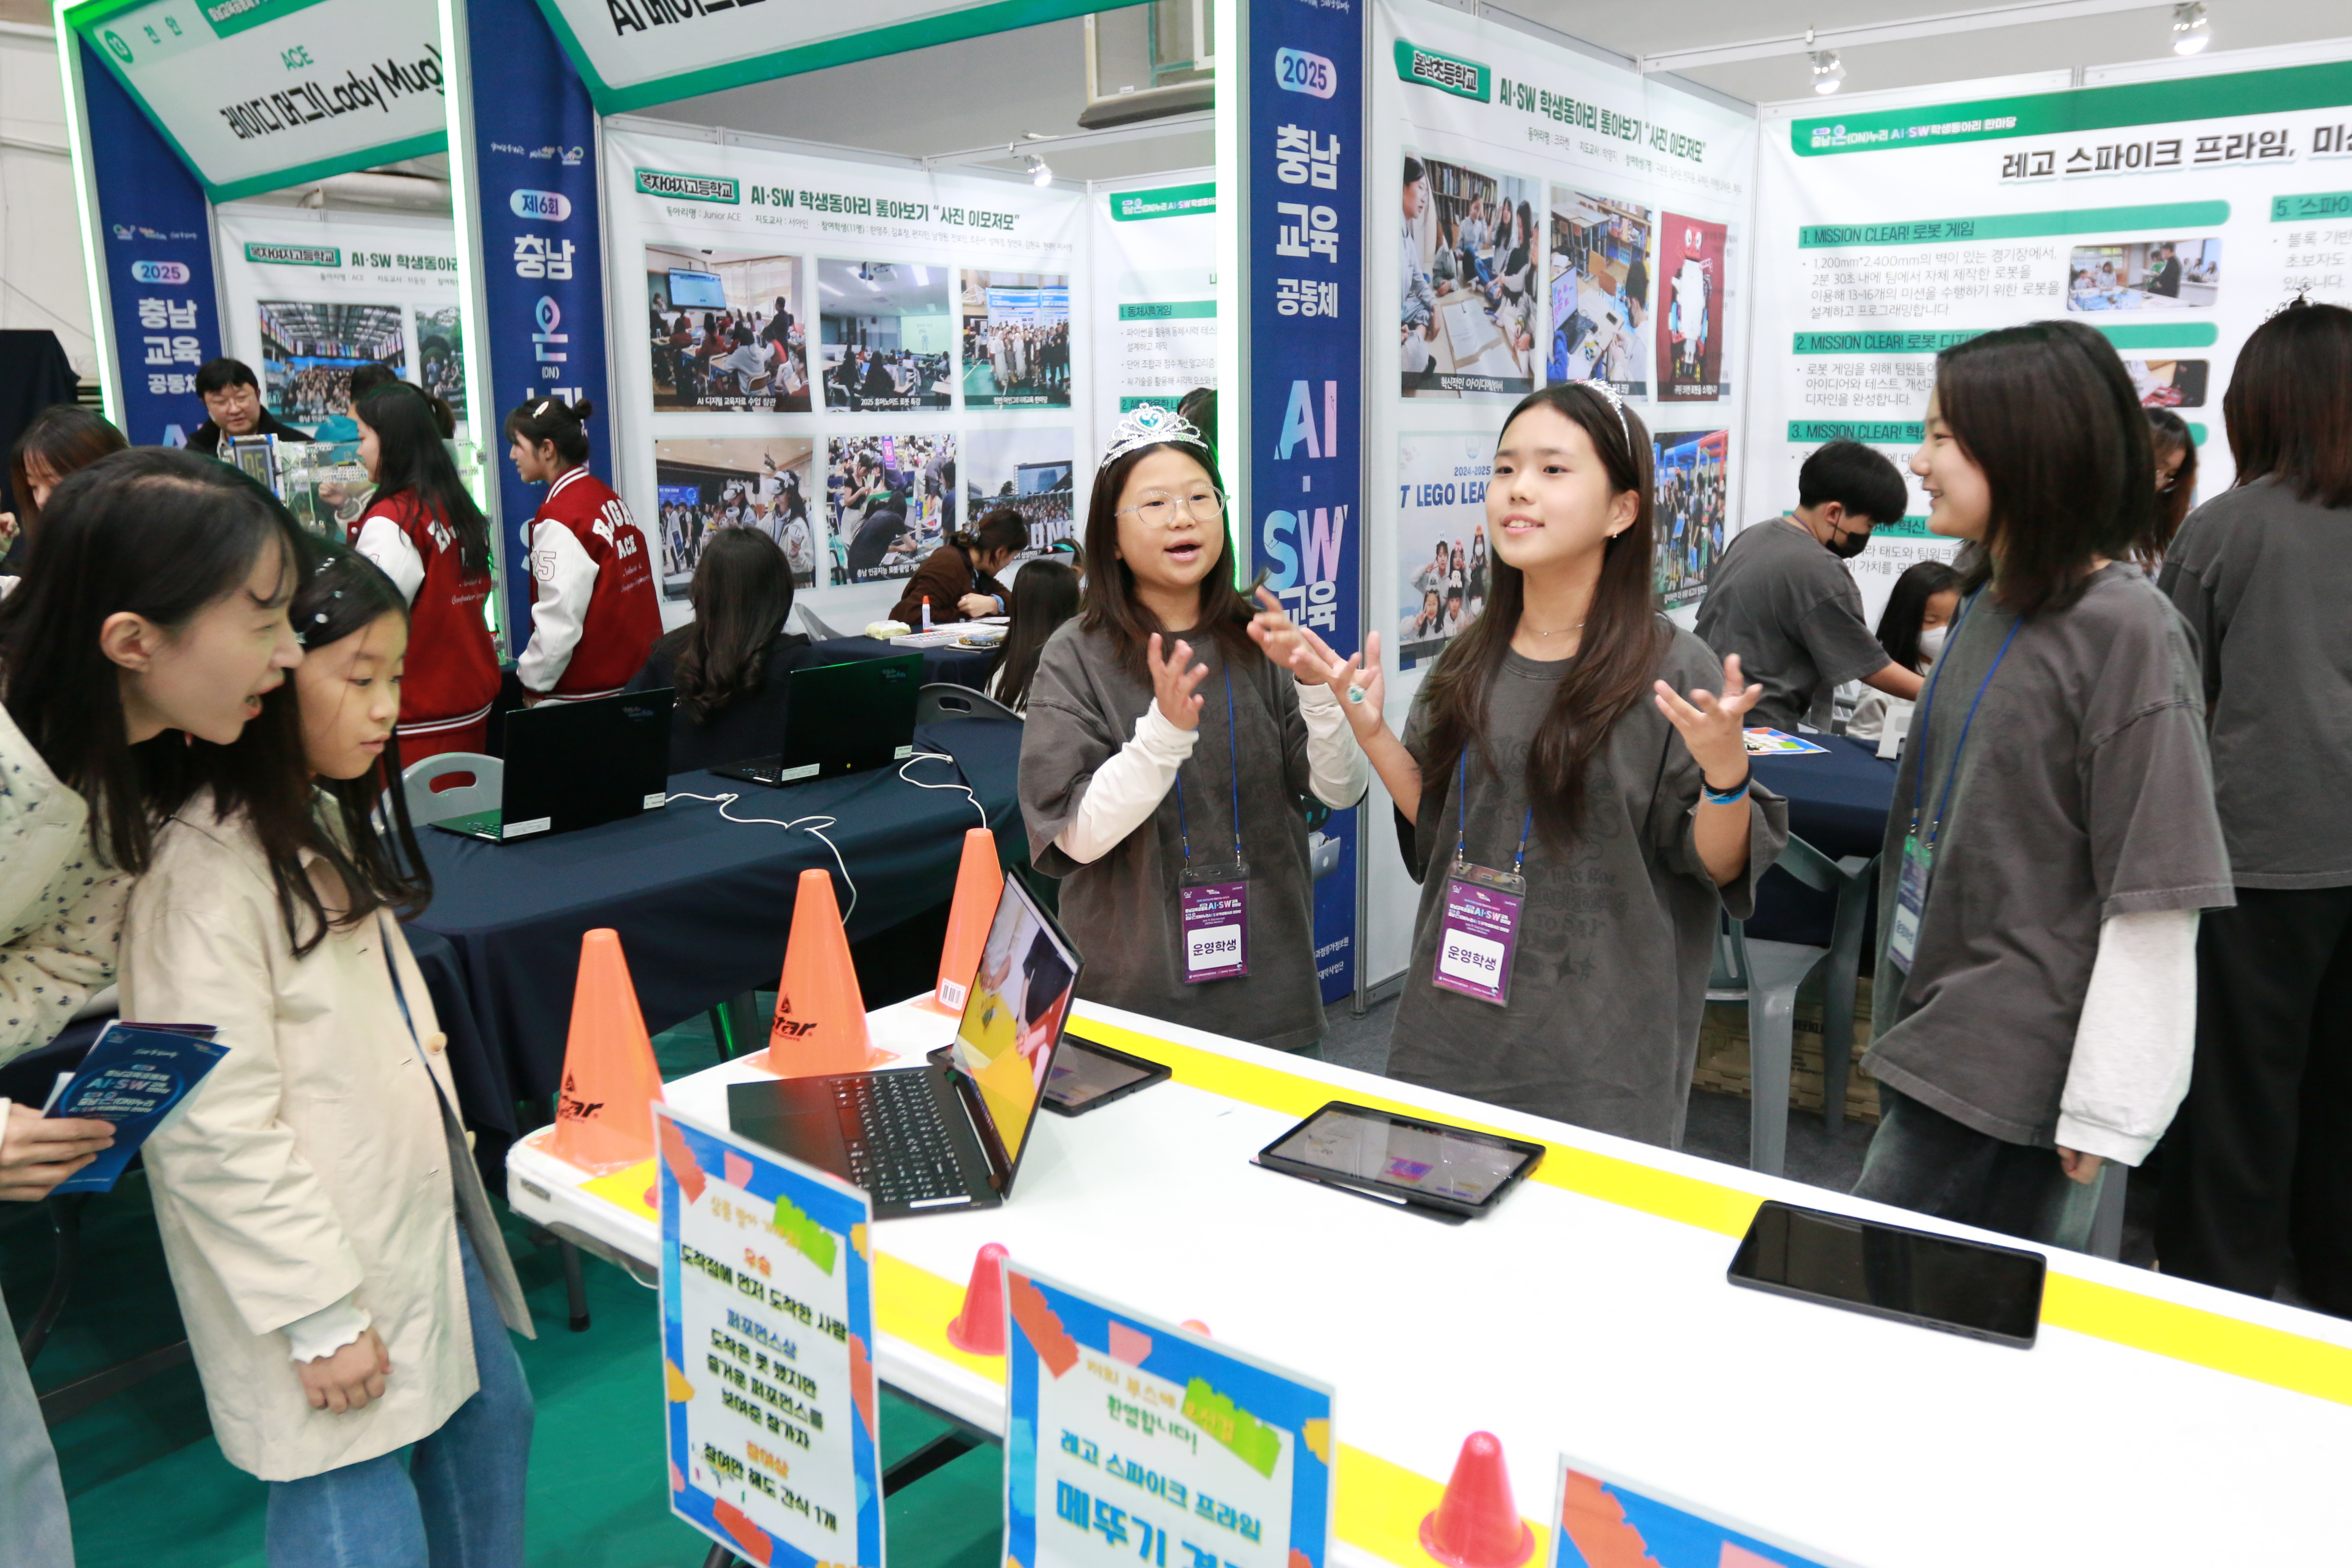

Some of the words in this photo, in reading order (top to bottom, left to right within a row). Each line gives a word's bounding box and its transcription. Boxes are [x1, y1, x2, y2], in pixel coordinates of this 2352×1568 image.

[281, 45, 314, 71] ACE
[1281, 55, 1329, 91] 2025
[1500, 77, 1537, 113] AI·SW
[1540, 89, 1598, 132] 학생동아리
[1601, 108, 1642, 144] 톺아보기
[1528, 126, 1550, 146] 동아리명
[1891, 126, 1930, 140] AI·SW
[1930, 118, 1982, 136] 학생동아리
[1984, 116, 2018, 130] 한마당
[1275, 124, 1340, 190] 충남
[2003, 149, 2056, 179] 레고
[2065, 138, 2183, 174] 스파이크
[2193, 129, 2296, 163] 프라임,
[2313, 124, 2352, 153] 미
[640, 173, 733, 198] 복자여자고등학교
[522, 194, 559, 215] 제6회
[666, 206, 697, 219] 동아리명
[703, 209, 726, 220] Junior
[727, 212, 741, 221] ACE
[751, 185, 794, 208] AI·SW
[799, 189, 871, 216] 학생동아리
[875, 199, 929, 222] 톺아보기
[2276, 199, 2290, 217] 5.
[755, 214, 783, 226] 지도교사
[788, 217, 808, 229] 서아인
[1276, 201, 1339, 263] 교육
[1803, 230, 1810, 245] 1.
[1814, 227, 1862, 244] MISSION
[1865, 225, 1910, 243] CLEAR!
[1913, 224, 1942, 240] 로봇
[1945, 221, 1975, 238] 게임
[2288, 231, 2319, 248] 블록
[250, 245, 336, 263] 복자여자고등학교
[351, 251, 392, 268] AI·SW
[514, 234, 576, 280] 충남
[1936, 251, 1960, 265] 벽이
[1963, 250, 1988, 263] 있는
[1991, 246, 2058, 262] 경기장에서,
[2285, 251, 2346, 268] 초보자도
[141, 264, 181, 281] 2025
[351, 273, 364, 282] ACE
[1812, 273, 1831, 287] 2분
[1834, 272, 1856, 286] 30초
[1859, 271, 1881, 285] 내에
[1885, 270, 1921, 285] 팀에서
[1924, 268, 1949, 282] 자체
[1953, 266, 1991, 282] 제작한
[1994, 264, 2033, 279] 로봇을
[1276, 278, 1338, 318] 공동체
[1811, 288, 1846, 303] 이용해
[1902, 286, 1937, 301] 미션을
[1941, 284, 1989, 299] 수행하기
[1993, 283, 2018, 297] 위한
[2021, 280, 2061, 296] 로봇을
[138, 298, 197, 330] 충남
[1128, 305, 1157, 318] 동체시력
[1157, 304, 1173, 316] 게임
[1810, 305, 1855, 319] 설계하고
[1858, 303, 1951, 318] 프로그래밍합니다.
[1127, 327, 1154, 337] 파이썬을
[1172, 326, 1199, 337] 동체시력
[1797, 336, 1807, 350] 2.
[1810, 335, 1862, 350] MISSION
[1865, 334, 1904, 350] CLEAR!
[1908, 334, 1936, 350] 로봇
[143, 336, 202, 367] 교육
[1127, 342, 1153, 352] 설계하고
[1155, 342, 1168, 351] 제작
[542, 365, 559, 380] (ON)
[1127, 359, 1139, 369] 단어
[1142, 358, 1161, 369] 조합과
[1164, 358, 1176, 369] 점수
[1189, 358, 1216, 369] 알고리즘
[1807, 362, 1828, 376] 로봇
[1831, 361, 1866, 376] 게임을
[1869, 361, 1892, 376] 위해
[1127, 377, 1134, 385] AI
[1134, 376, 1153, 386] 기술을
[1155, 376, 1175, 386] 활용해
[1440, 376, 1464, 390] 혁신적인
[1807, 377, 1862, 391] 아이디어와
[1865, 377, 1902, 391] 테스트,
[697, 396, 704, 405] AI
[705, 396, 723, 406] 디지털
[723, 396, 747, 407] 교육자료
[747, 397, 761, 407] 수업
[762, 398, 777, 407] 참관
[861, 398, 873, 407] 2025
[874, 397, 899, 407] 휴머노이드
[900, 397, 910, 406] 로봇
[910, 397, 921, 406] 특강
[1806, 393, 1848, 407] 디자인을
[1852, 393, 1912, 407] 완성합니다.
[1274, 380, 1338, 460] AI
[1792, 424, 1802, 438] 3.
[1806, 424, 1855, 439] MISSION
[1858, 425, 1902, 439] CLEAR!
[1454, 465, 1491, 477] 2024-2025
[1417, 482, 1455, 507] LEGO
[1461, 481, 1490, 505] LEA
[1899, 520, 1926, 535] 혁신
[616, 534, 637, 560] ACE
[1263, 504, 1349, 592] SW
[1880, 545, 1914, 559] 태도와
[869, 566, 887, 576] 인공지능
[888, 565, 898, 575] 로봇
[1859, 560, 1893, 574] 가치를
[1193, 938, 1237, 956] 운영학생
[1314, 936, 1349, 958] 과정평가정보원
[1448, 945, 1497, 971] 운영학생
[737, 1271, 765, 1303] 먼저
[769, 1288, 813, 1327] 도착한
[726, 1308, 797, 1360] 퍼포먼스상
[772, 1360, 817, 1400] 했지만
[707, 1352, 747, 1391] 즐거운
[750, 1375, 824, 1433] 퍼포먼스를
[1126, 1374, 1176, 1411] 부스에
[722, 1387, 763, 1426] 보여준
[766, 1411, 810, 1452] 참가자
[1106, 1392, 1198, 1456] 환영합니다!
[1060, 1428, 1099, 1467] 레고
[1106, 1452, 1188, 1510] 스파이크
[1194, 1491, 1262, 1546] 프라임
[748, 1467, 777, 1500] 해도
[779, 1484, 809, 1519] 간식
[814, 1505, 838, 1534] 1개
[1056, 1478, 1167, 1568] 메뚜기
